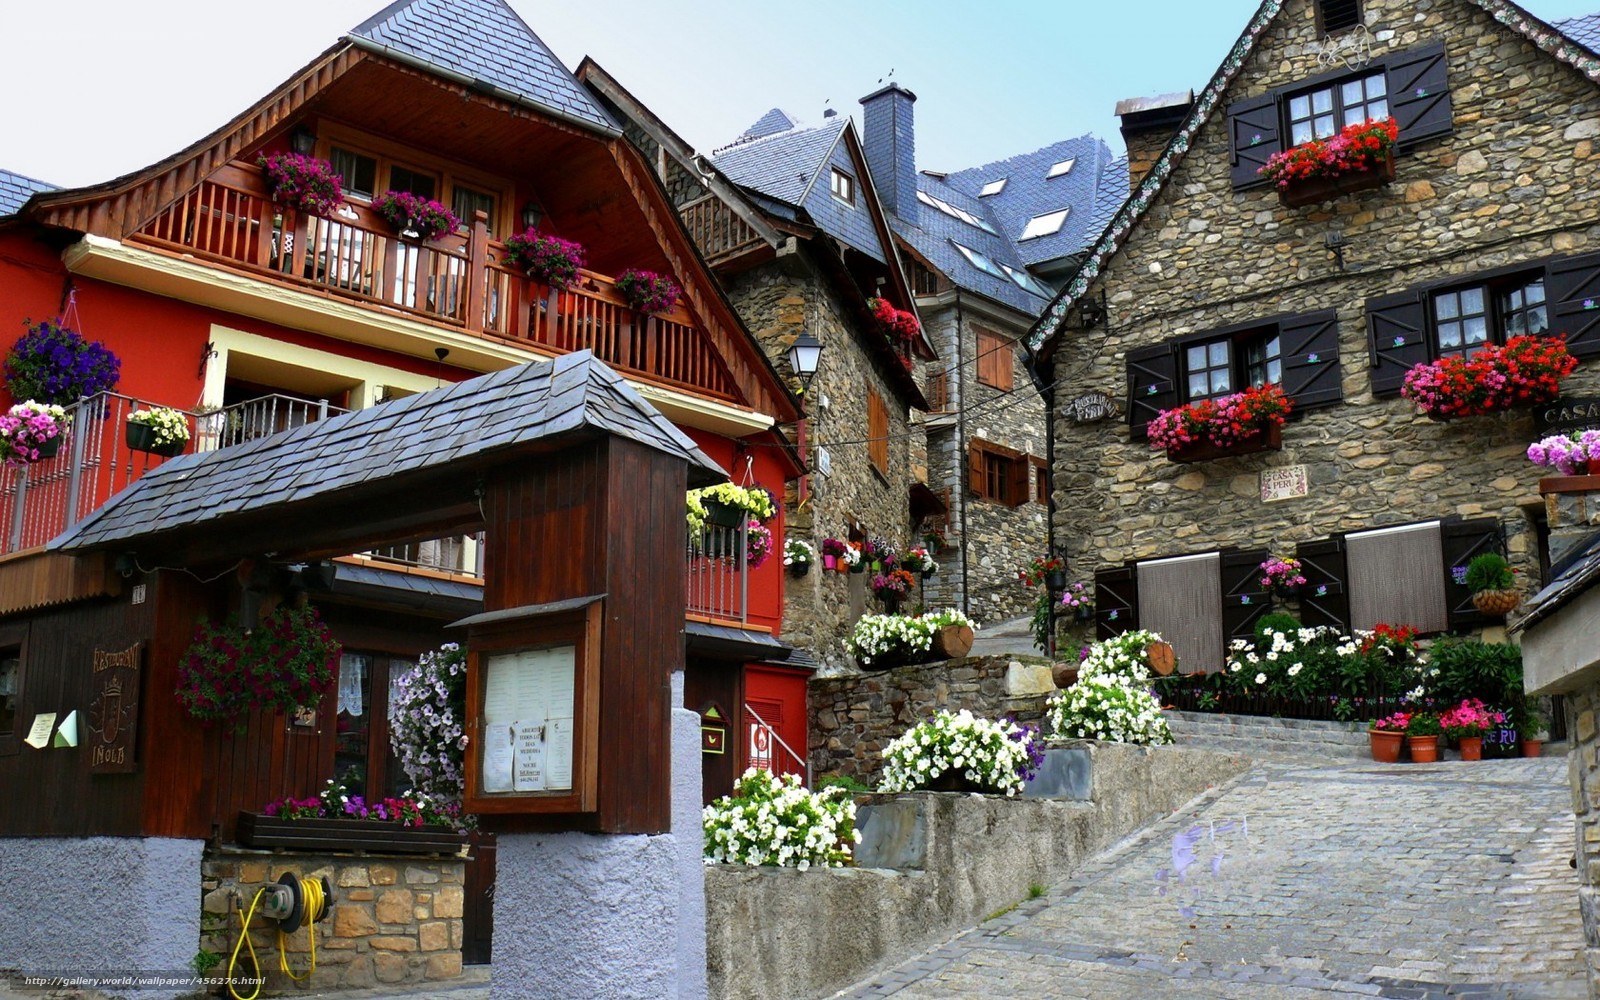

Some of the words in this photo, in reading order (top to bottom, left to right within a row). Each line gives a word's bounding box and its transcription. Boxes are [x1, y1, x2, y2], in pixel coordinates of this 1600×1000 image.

[1545, 403, 1599, 423] CASA
[1272, 471, 1294, 481] CASA
[1273, 479, 1295, 490] PERU
